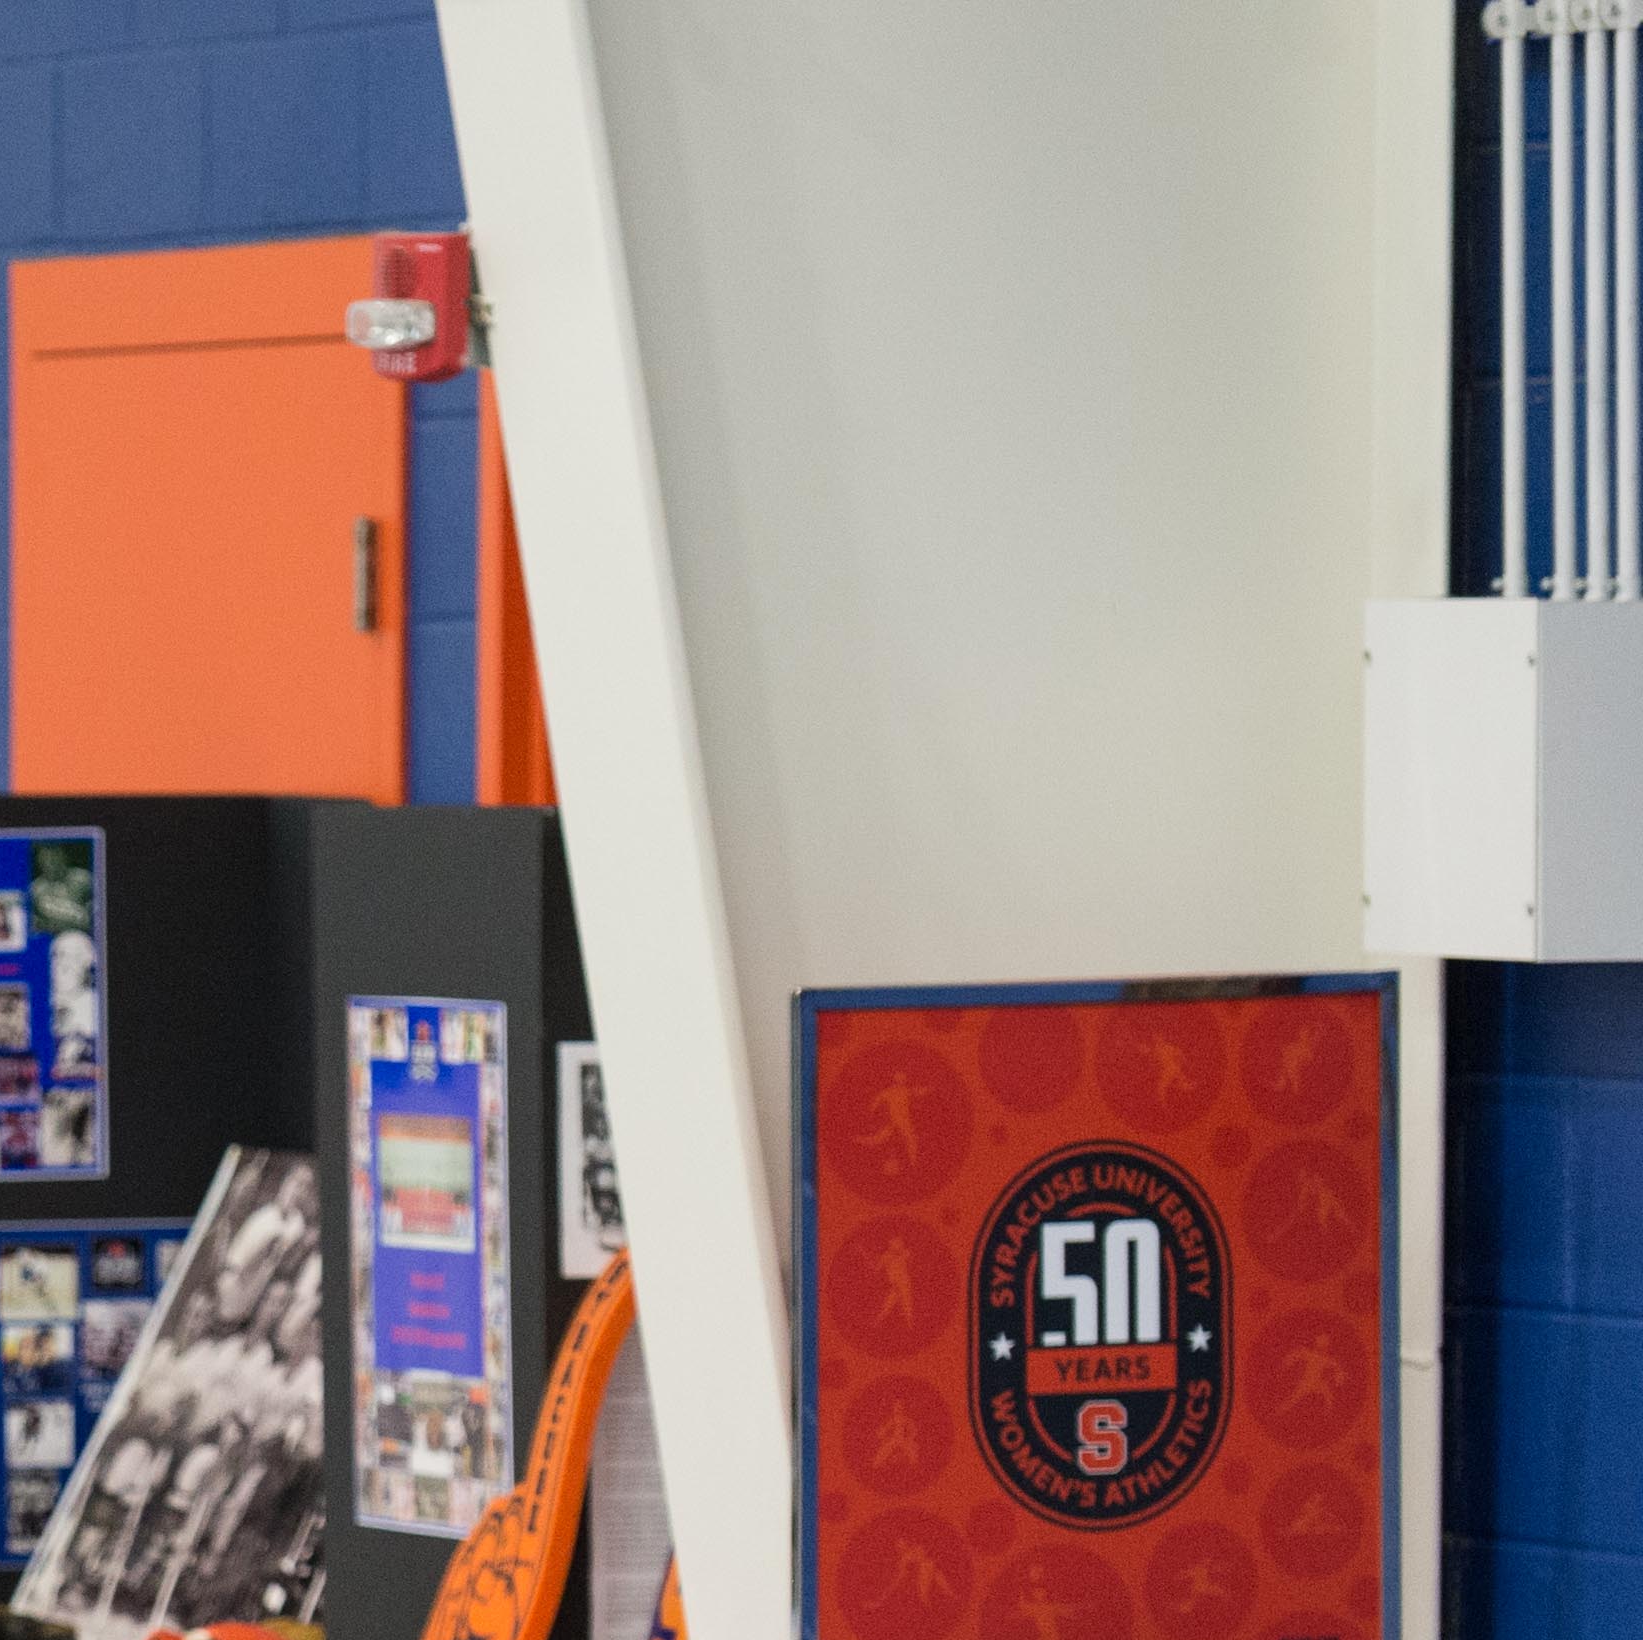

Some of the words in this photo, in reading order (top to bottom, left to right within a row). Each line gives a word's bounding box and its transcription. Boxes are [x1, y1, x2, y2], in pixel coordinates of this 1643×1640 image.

[990, 1165, 1087, 1308] SYRACUSE
[1093, 1163, 1213, 1298] UNIVERSITY
[1041, 1218, 1161, 1347] 50
[1053, 1355, 1153, 1384] YEARS
[990, 1388, 1097, 1508] WOMEN'S
[1105, 1378, 1213, 1508] ATHLETICS
